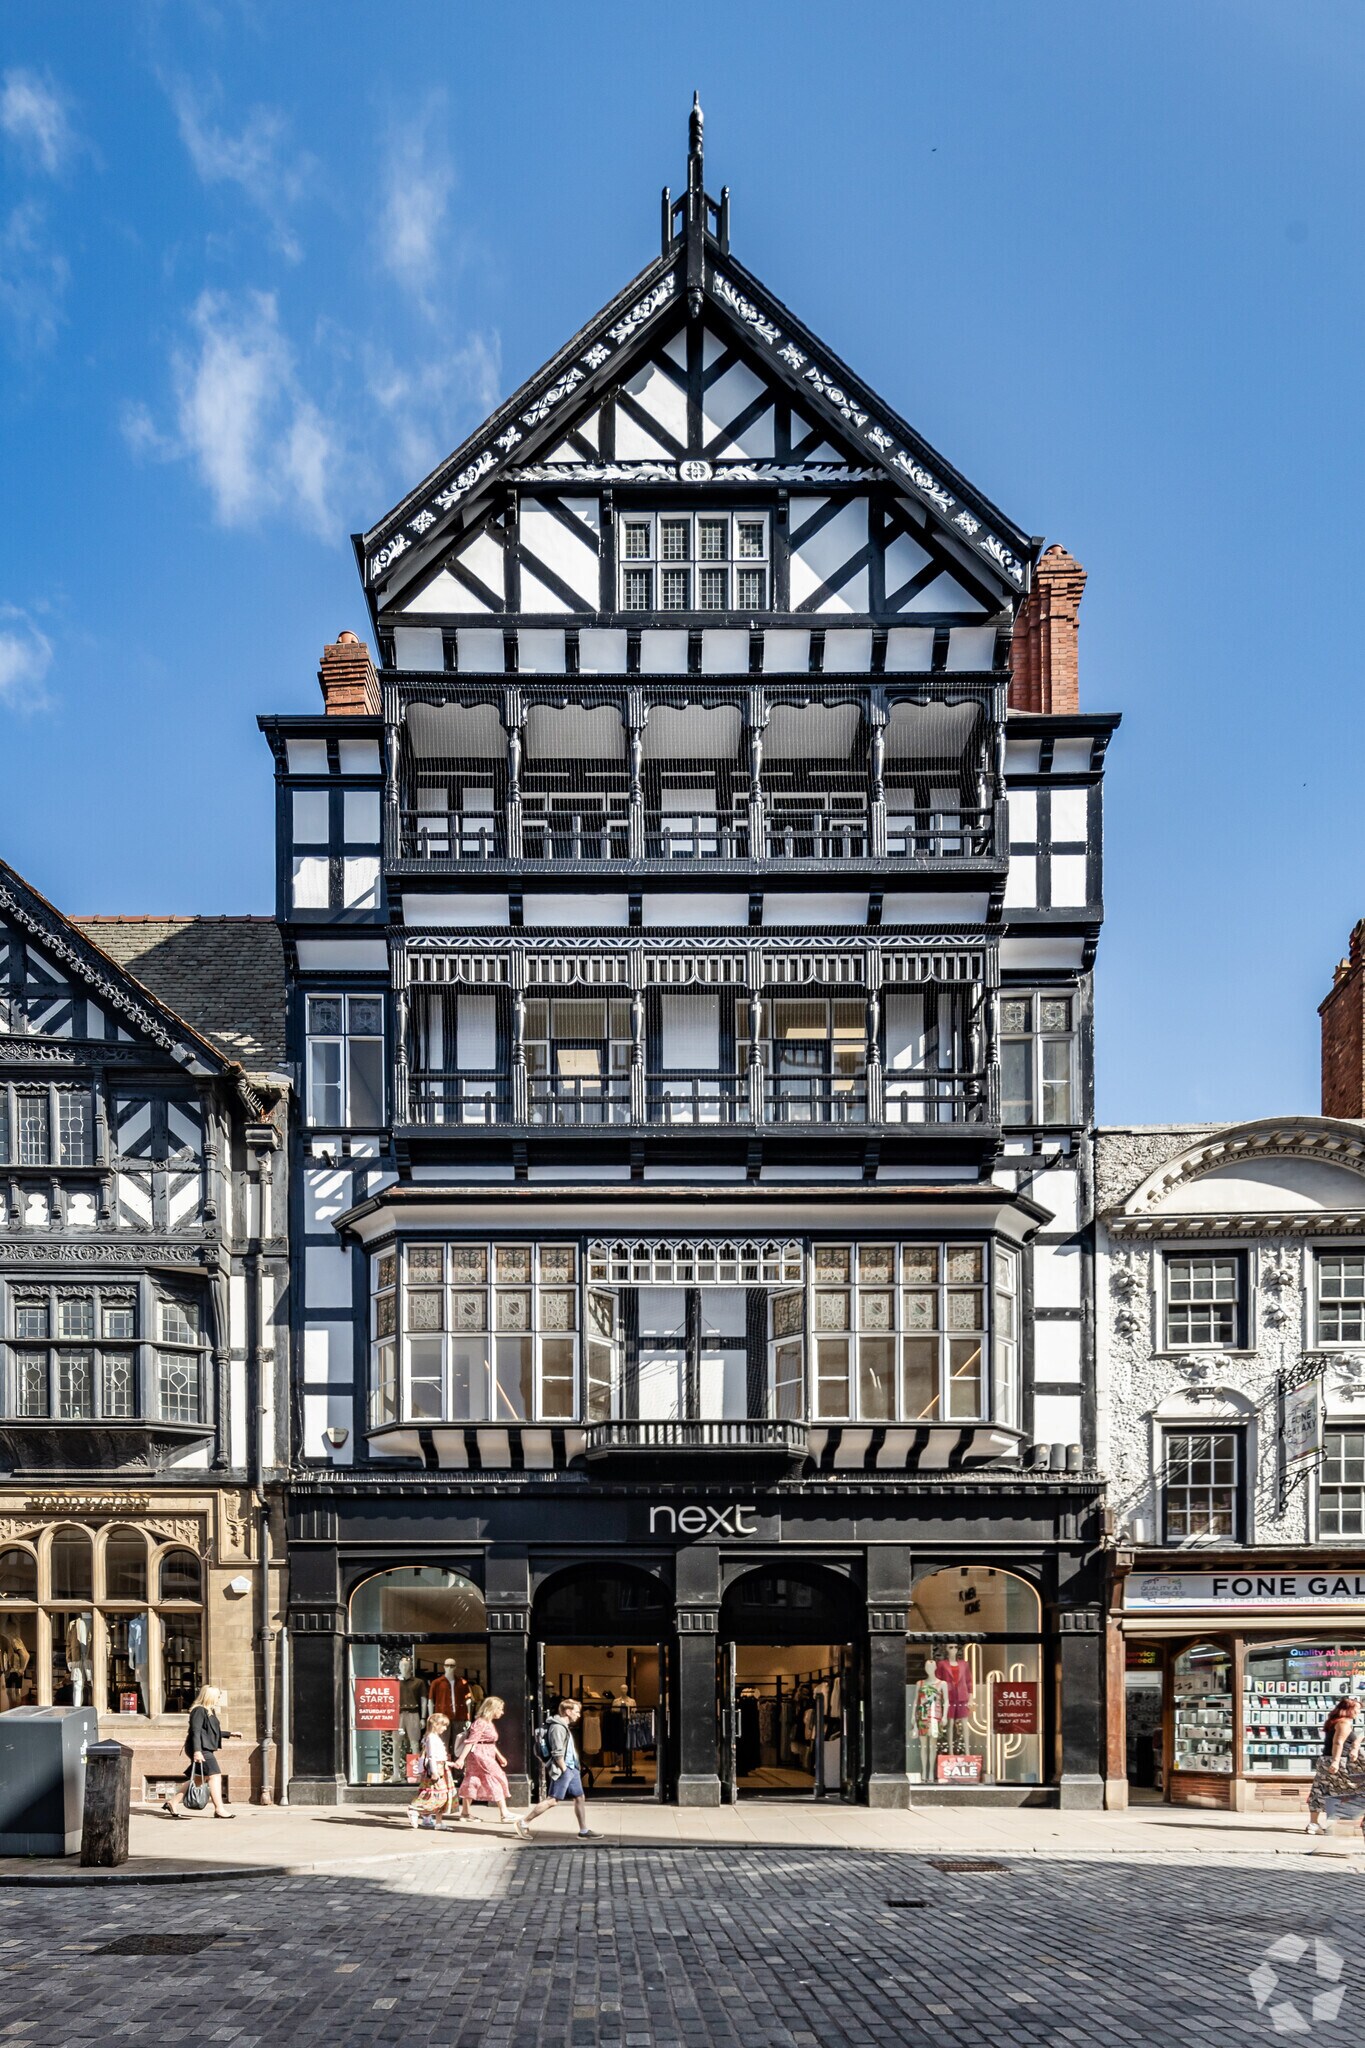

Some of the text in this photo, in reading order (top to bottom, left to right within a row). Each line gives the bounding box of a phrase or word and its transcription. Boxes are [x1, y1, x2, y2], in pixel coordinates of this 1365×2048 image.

[650, 1504, 758, 1534] next
[1213, 1577, 1365, 1596] FONE GAL
[1290, 1648, 1323, 1657] Quality
[1337, 1648, 1357, 1656] best
[364, 1687, 390, 1695] SALE
[1002, 1691, 1028, 1699] SALE
[360, 1695, 395, 1704] STARTS
[998, 1699, 1033, 1707] STARTS
[943, 1766, 978, 1776] SALE
